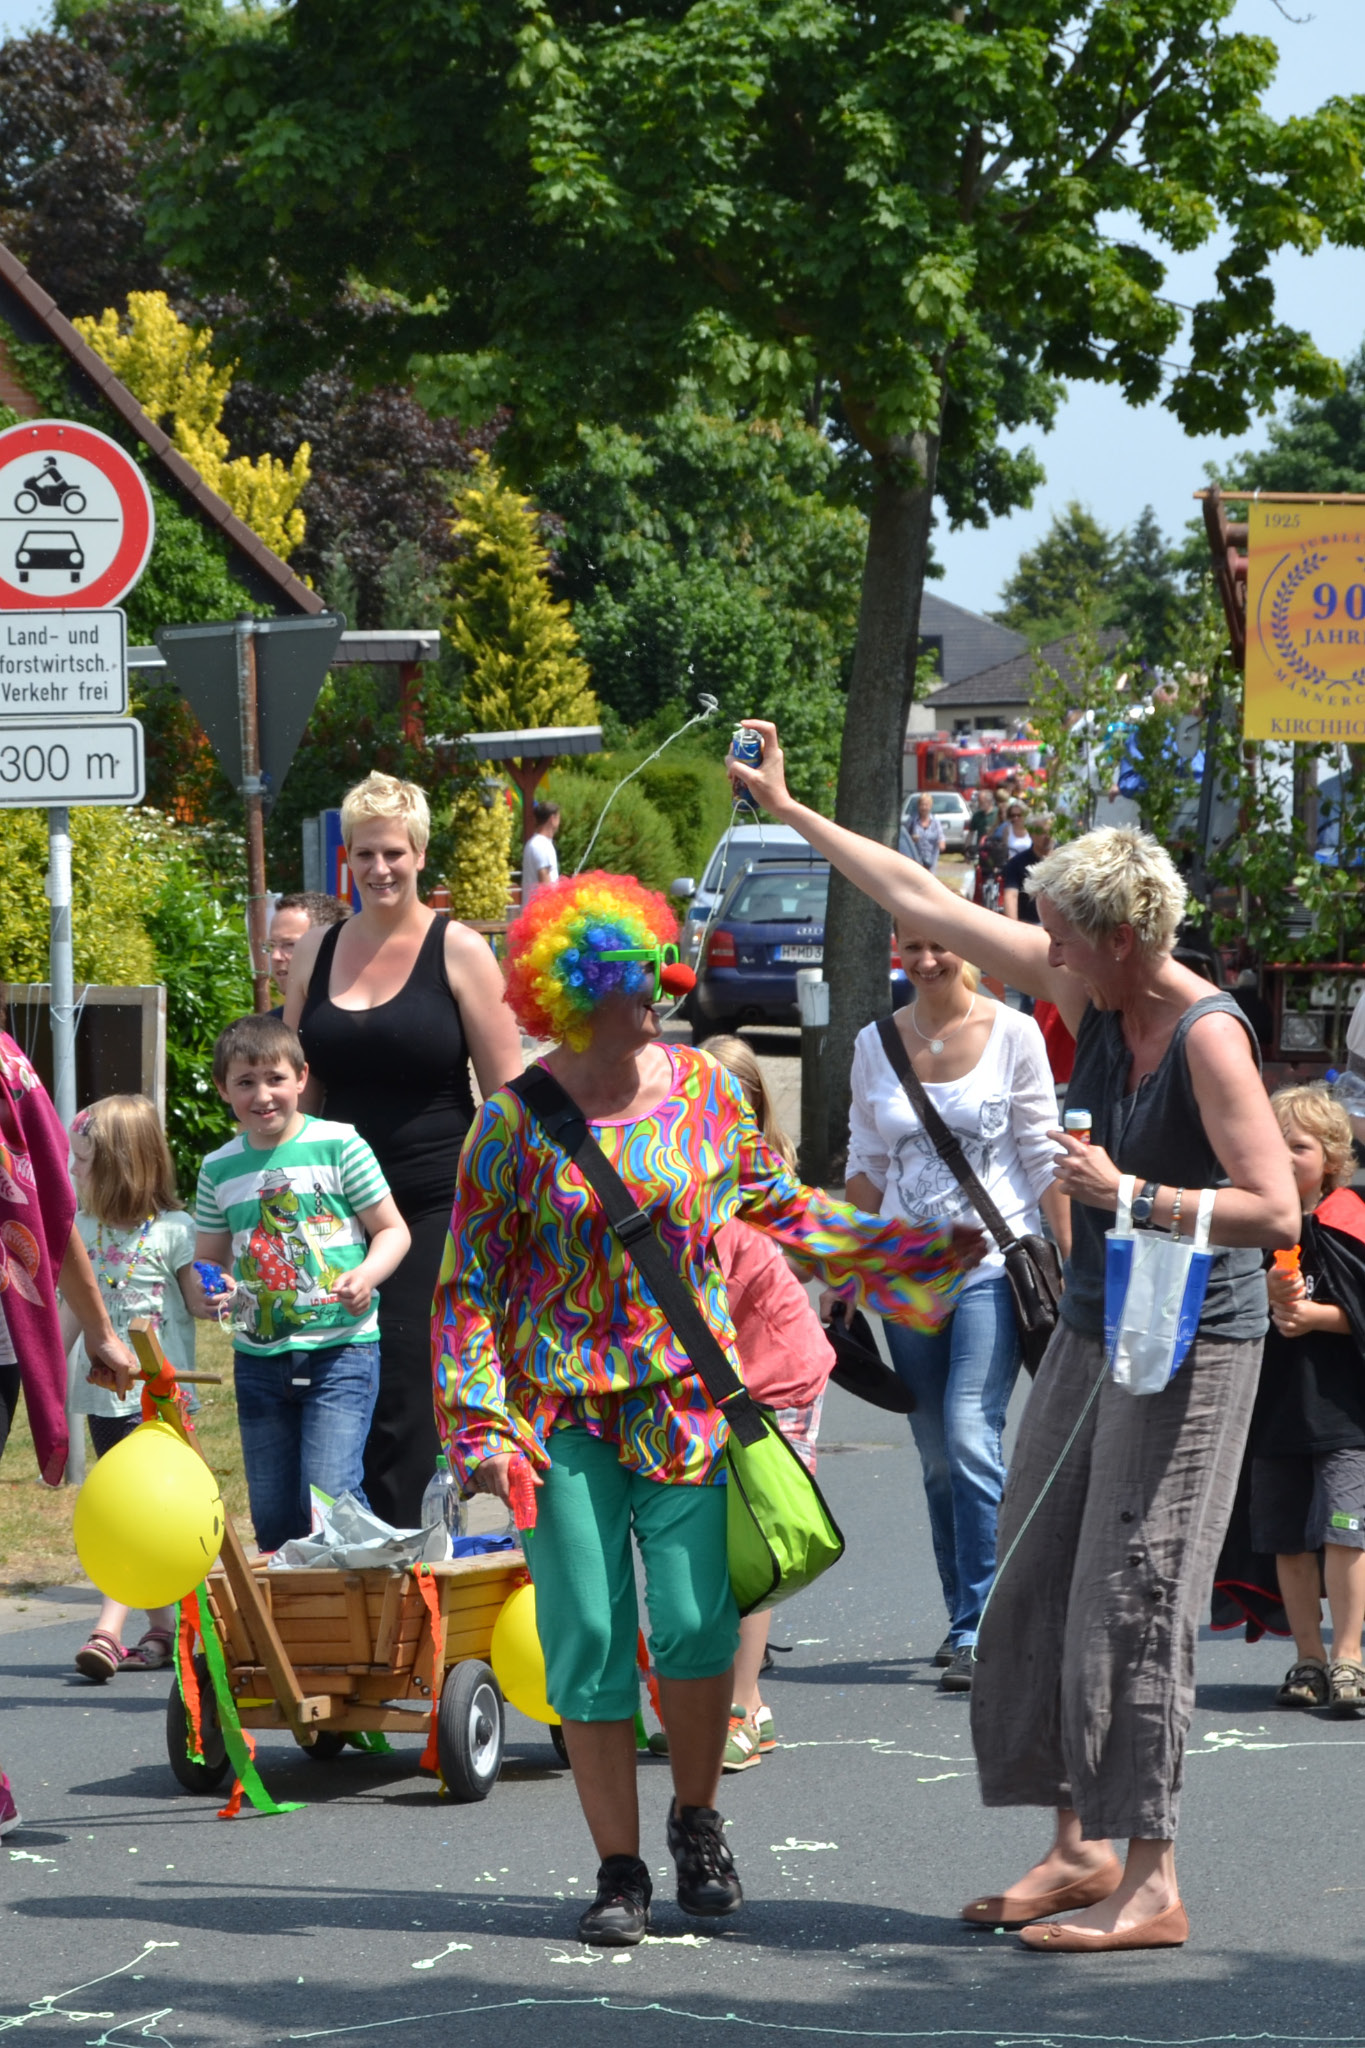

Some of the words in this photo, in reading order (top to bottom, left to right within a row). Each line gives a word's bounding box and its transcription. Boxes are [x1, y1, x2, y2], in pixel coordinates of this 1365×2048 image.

[1264, 513, 1301, 528] 1925
[1300, 531, 1365, 555] JUBILÄ
[1313, 583, 1365, 621] 90
[8, 625, 59, 646] Land-
[68, 624, 99, 644] und
[1302, 628, 1365, 648] JAHR
[0, 653, 110, 674] forstwirtsch.
[1, 682, 68, 702] Verkehr
[79, 681, 108, 701] frei
[0, 744, 70, 783] 300
[86, 752, 116, 780] m
[731, 1730, 753, 1755] N
